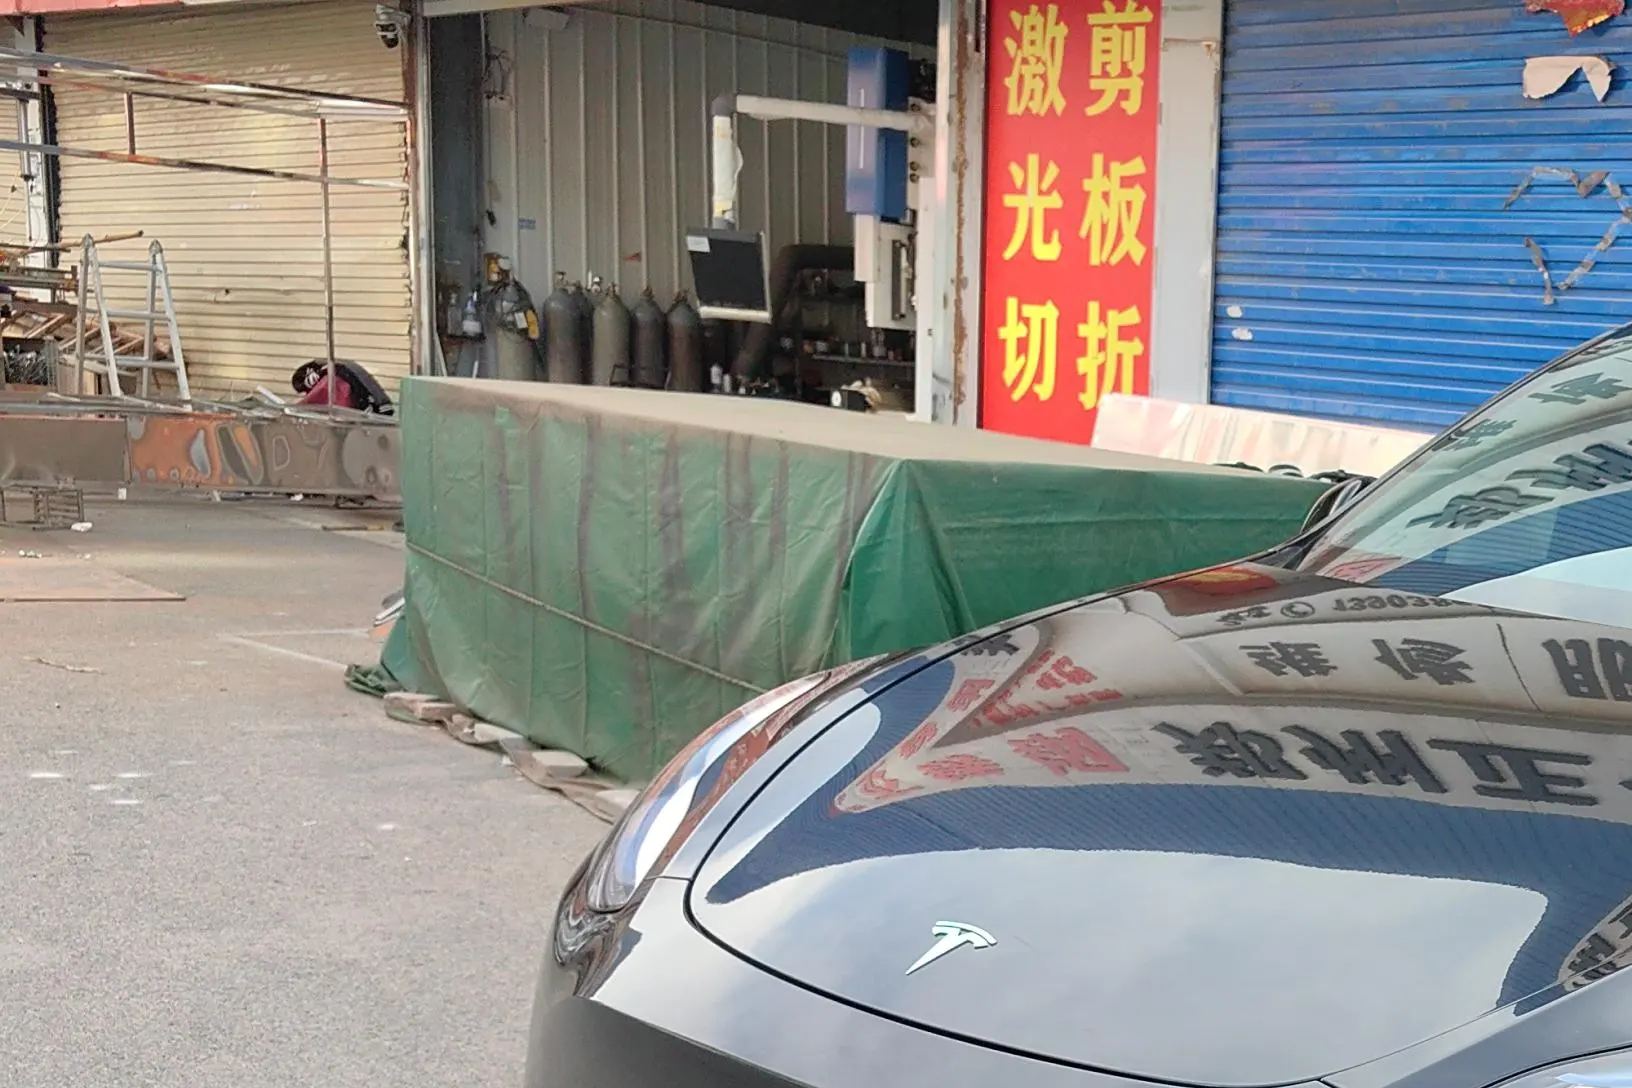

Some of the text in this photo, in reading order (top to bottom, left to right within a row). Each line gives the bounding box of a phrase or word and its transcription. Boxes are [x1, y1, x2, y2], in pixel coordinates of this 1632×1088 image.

[998, 3, 1069, 403] 激光切
[1077, 0, 1154, 411] 剪板折
